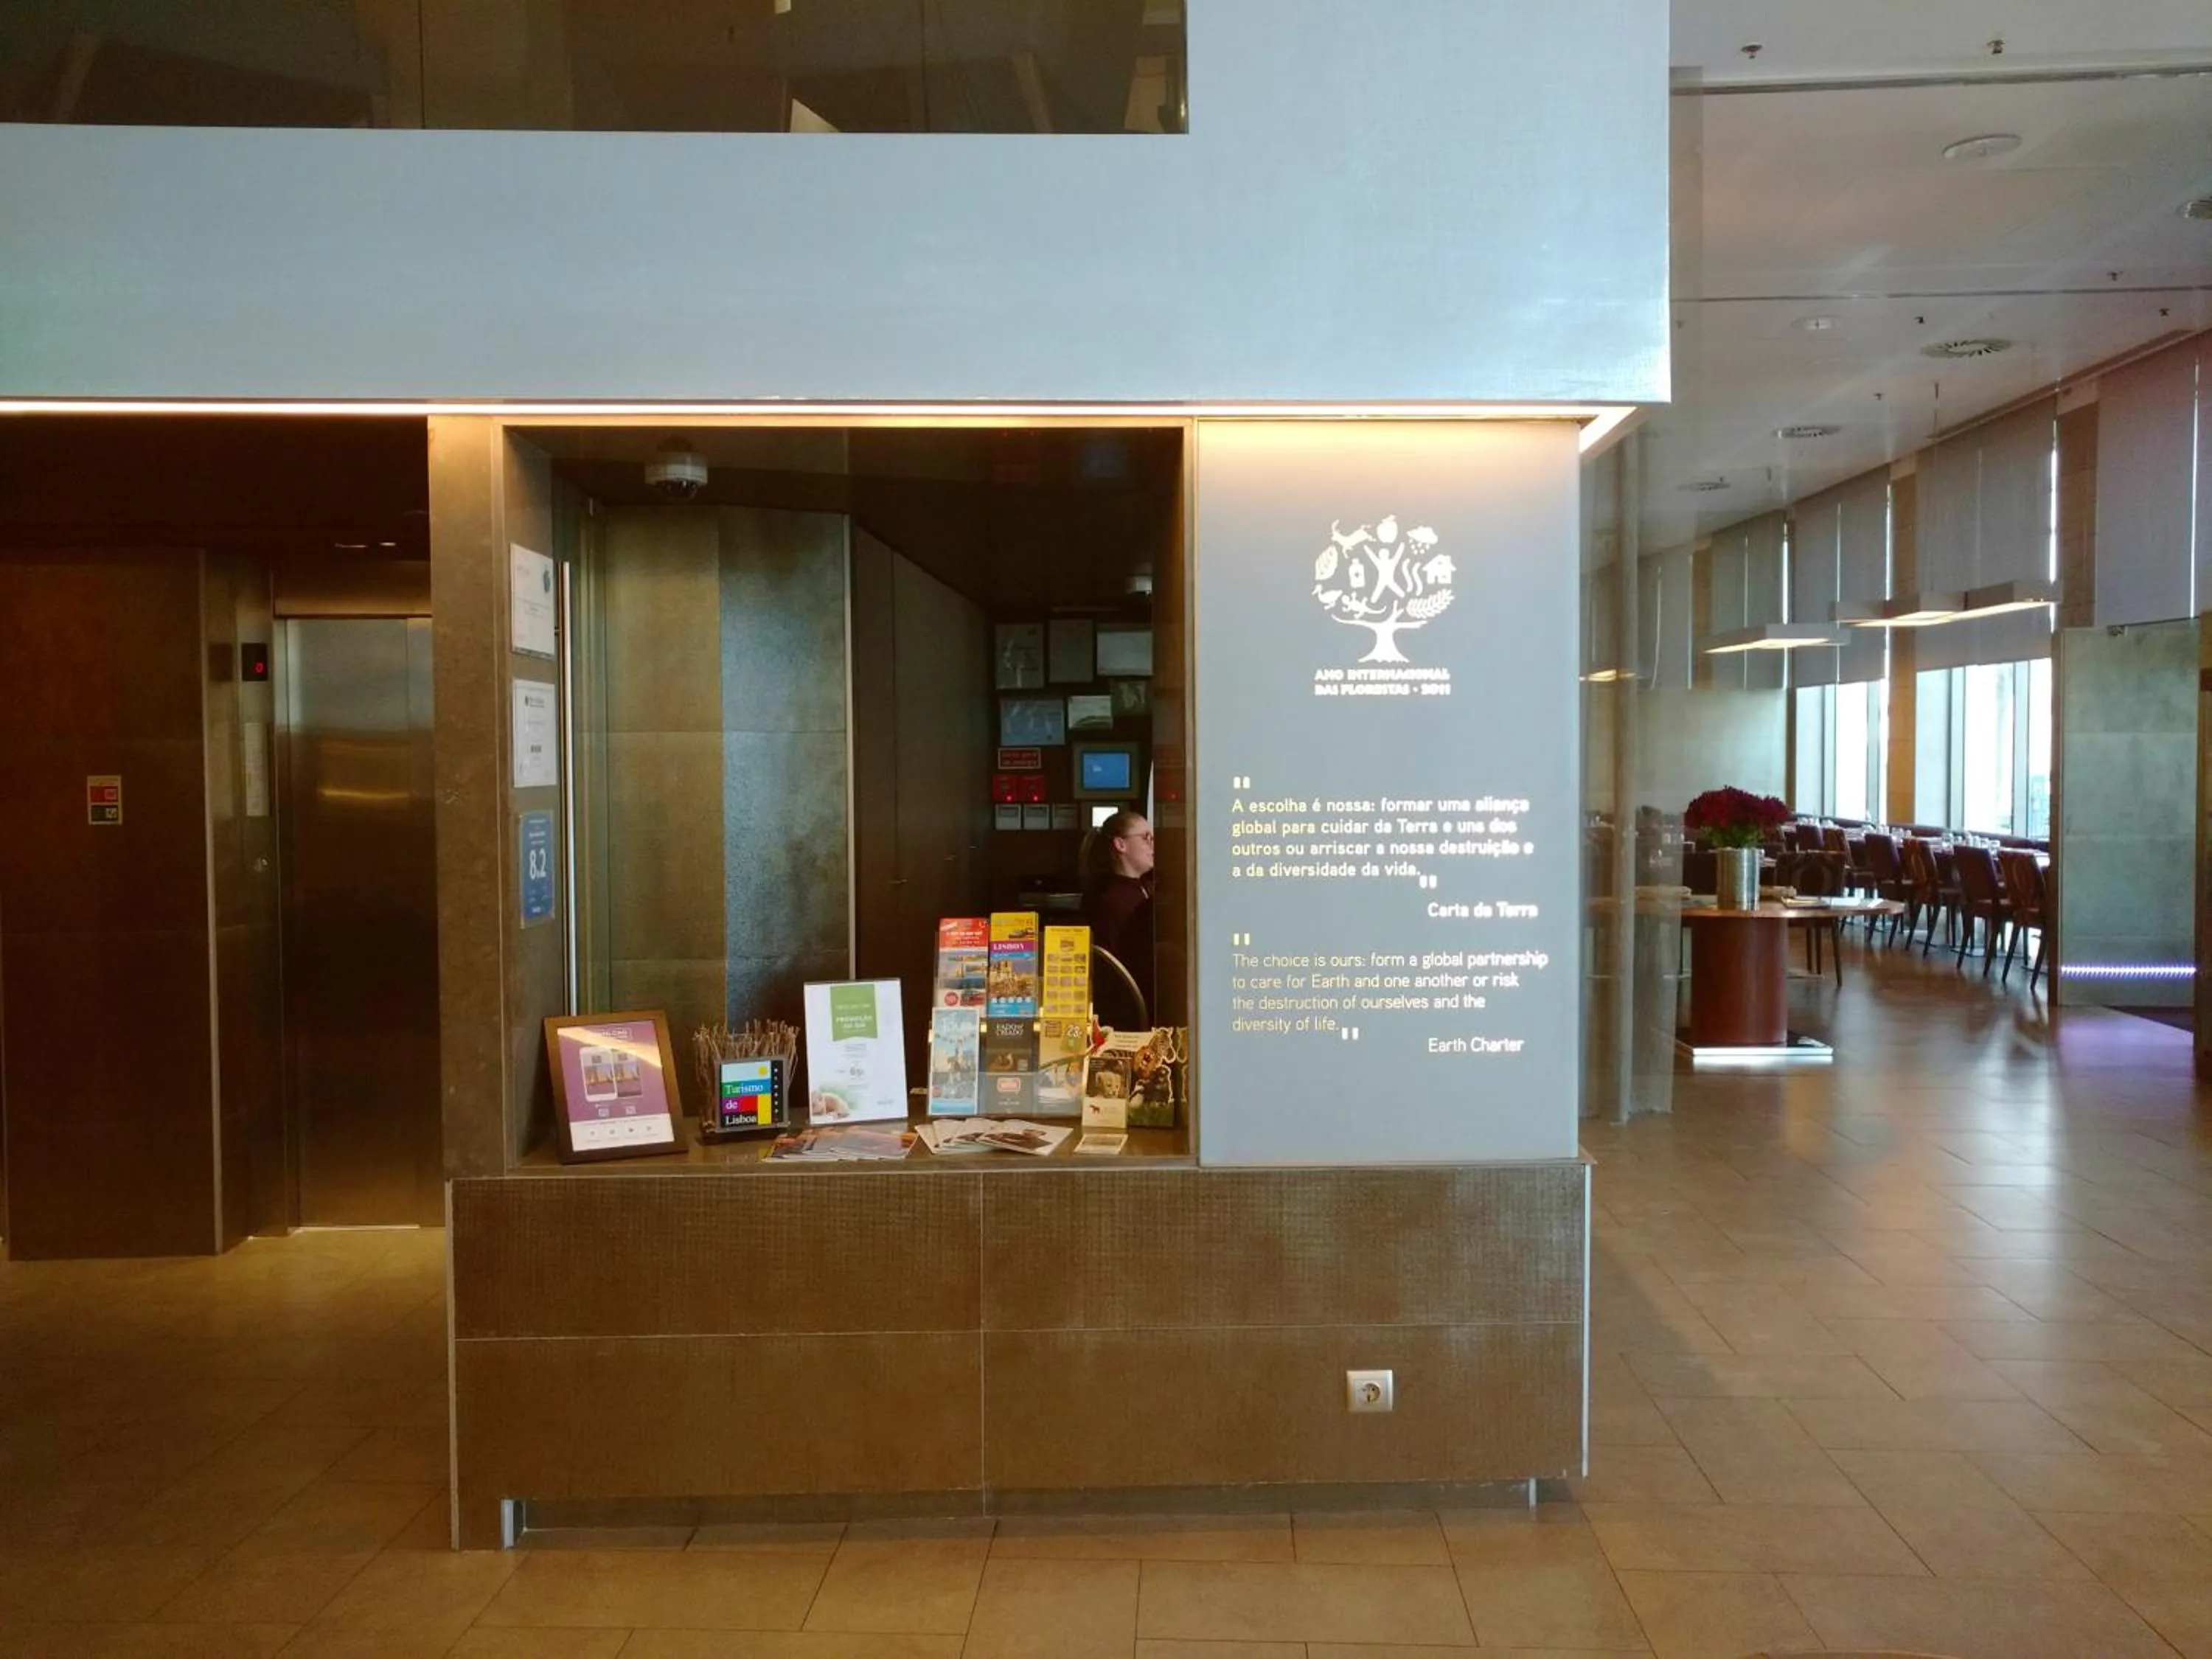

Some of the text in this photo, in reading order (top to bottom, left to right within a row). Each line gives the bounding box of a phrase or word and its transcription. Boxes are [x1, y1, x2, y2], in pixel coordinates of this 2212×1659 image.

[1315, 669, 1344, 681] ANO
[1232, 796, 1530, 814] A escolha é nossa: formar uma aliança
[1232, 818, 1517, 837] global para cuidar da Terra e uns dos
[1232, 840, 1534, 858] outros ou arriscar a nossa destruição e
[1232, 867, 1241, 877] a
[1246, 863, 1264, 877] da
[1269, 862, 1356, 877] diversidade
[1361, 862, 1380, 876] da
[1427, 901, 1538, 918] Carta da Terra
[1233, 950, 1549, 970] The choice is ours: form a global partnership
[1233, 972, 1520, 988] to care for Earth and one another or risk
[1233, 993, 1486, 1009] the destruction of ourselves and the
[1233, 1017, 1291, 1034] diversity
[1296, 1017, 1310, 1030] of
[1427, 1037, 1525, 1052] Earth Charter
[725, 1082, 764, 1095] Turismo
[725, 1099, 738, 1110] de
[725, 1114, 757, 1125] Lisboa
